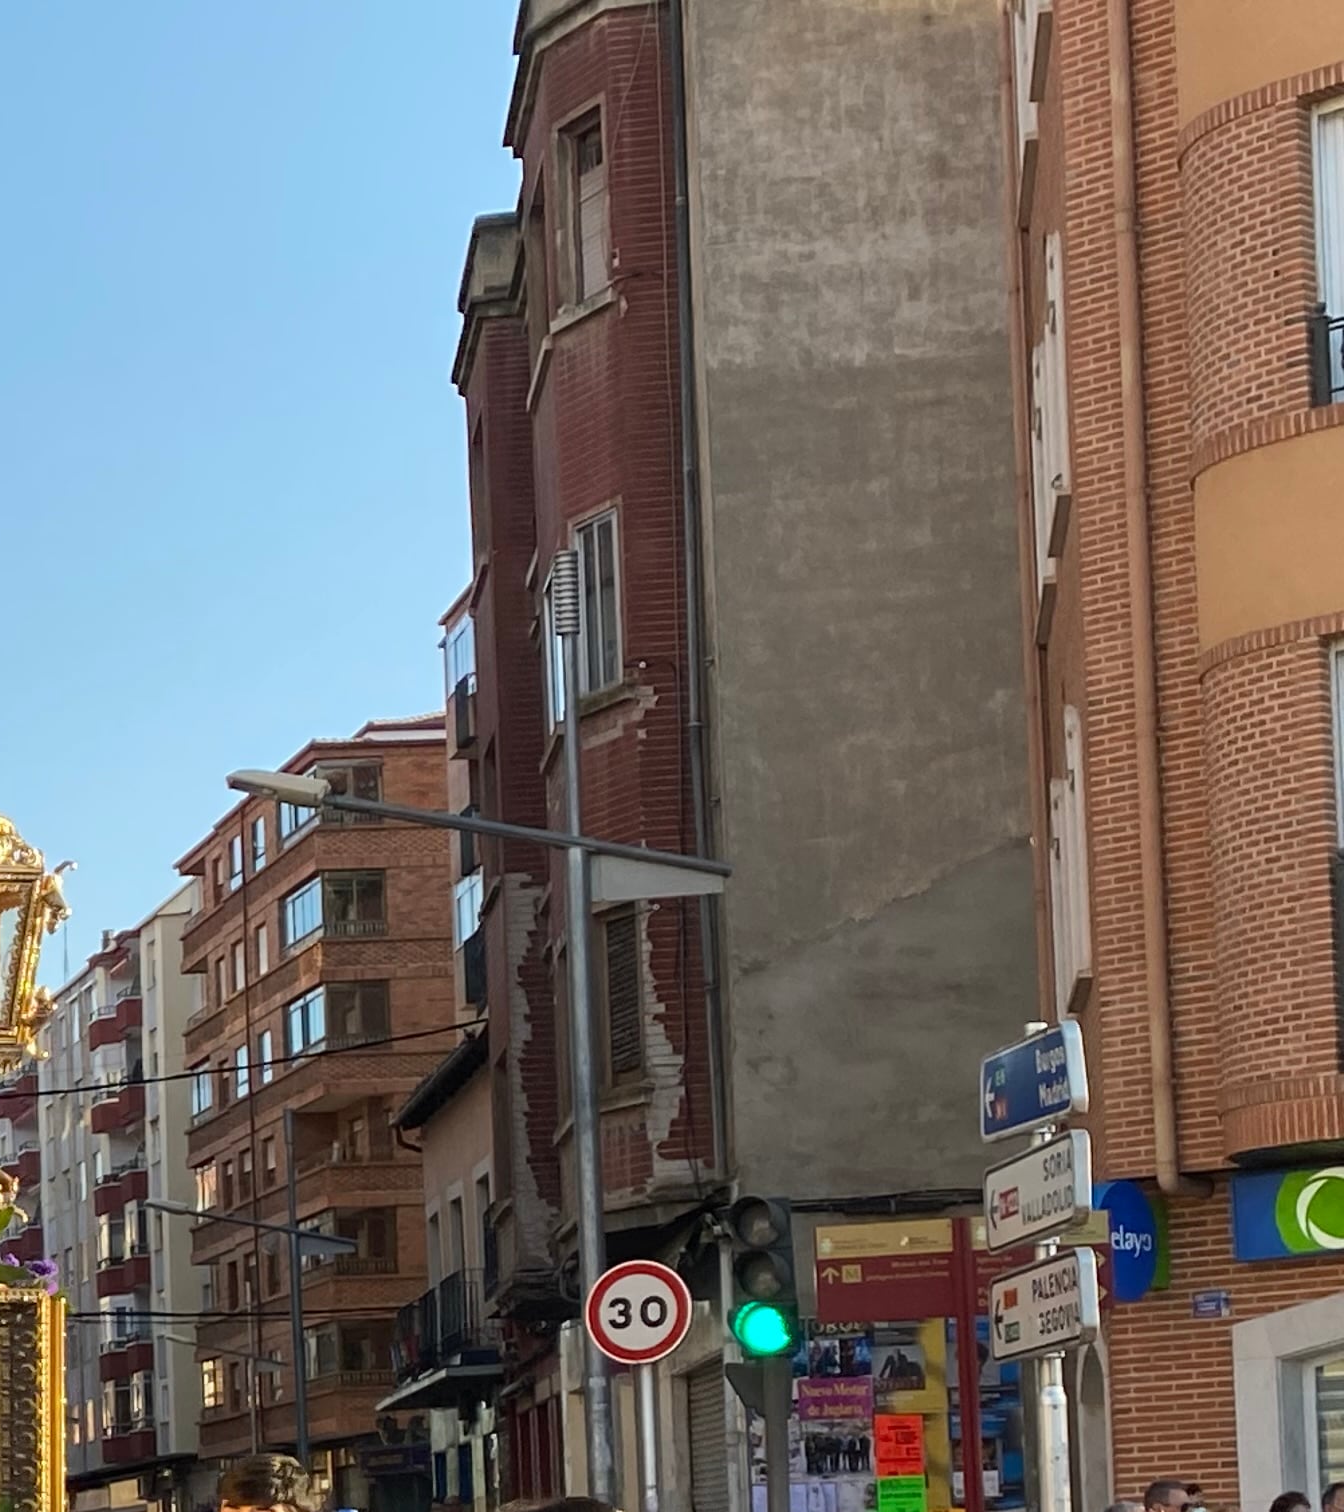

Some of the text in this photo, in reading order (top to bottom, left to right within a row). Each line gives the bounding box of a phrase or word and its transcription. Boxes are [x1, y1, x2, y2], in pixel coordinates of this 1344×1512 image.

[1035, 1045, 1065, 1074] Burgos
[1038, 1076, 1070, 1108] Madrid
[1042, 1148, 1072, 1182] SORIA
[1022, 1184, 1072, 1225] VALLADOLID
[1110, 1224, 1153, 1258] elayo
[1031, 1266, 1078, 1302] PALENCIA
[608, 1295, 668, 1329] 30
[1038, 1302, 1081, 1336] SEGOVIA
